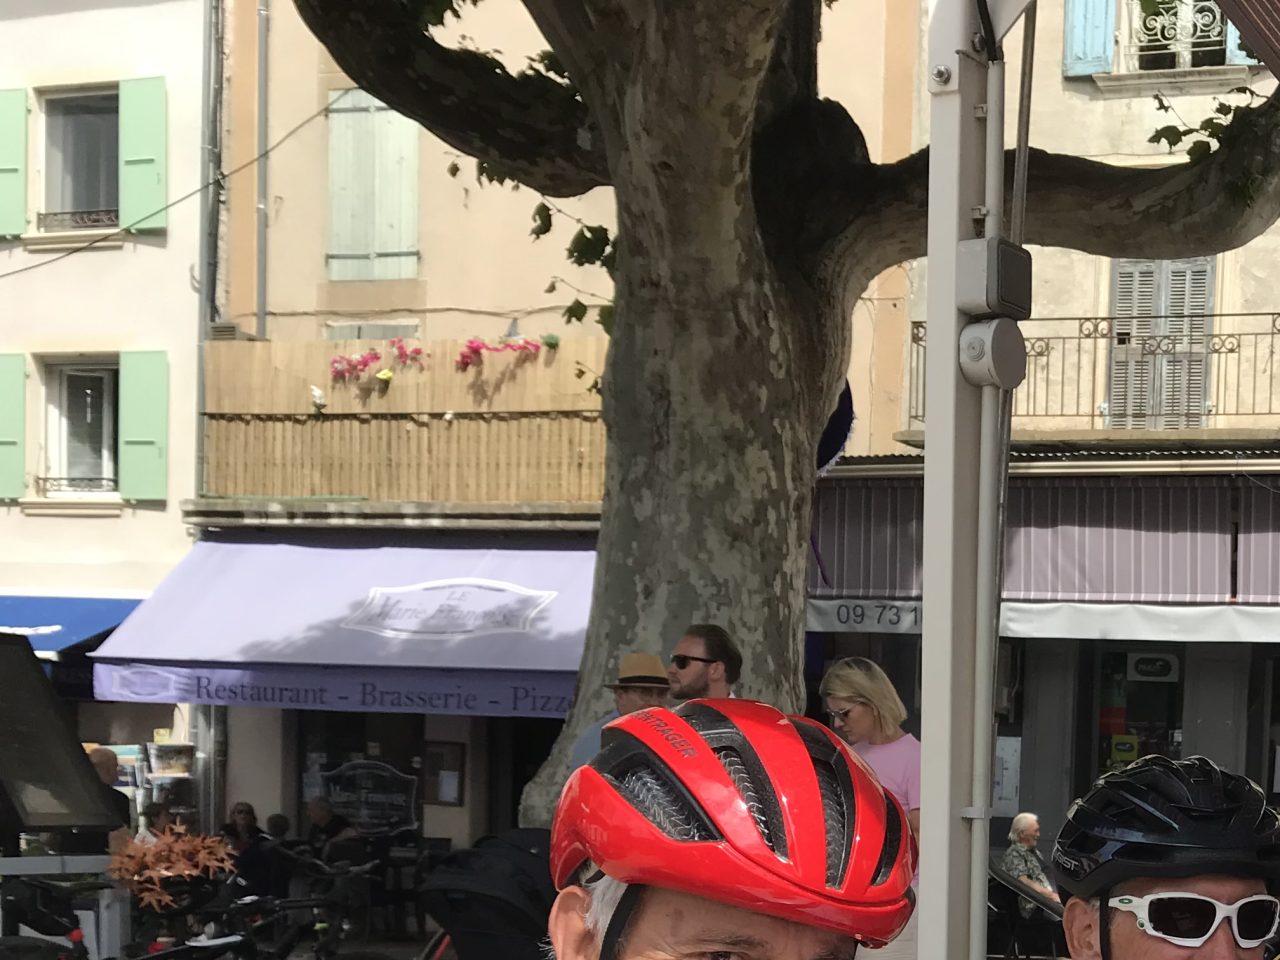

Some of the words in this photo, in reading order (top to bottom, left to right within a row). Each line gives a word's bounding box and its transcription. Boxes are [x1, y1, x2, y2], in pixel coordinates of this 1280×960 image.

[837, 604, 865, 625] 09
[874, 604, 901, 626] 73
[910, 606, 922, 626] 1
[194, 675, 329, 706] Restaurant
[360, 682, 479, 711] Brasserie
